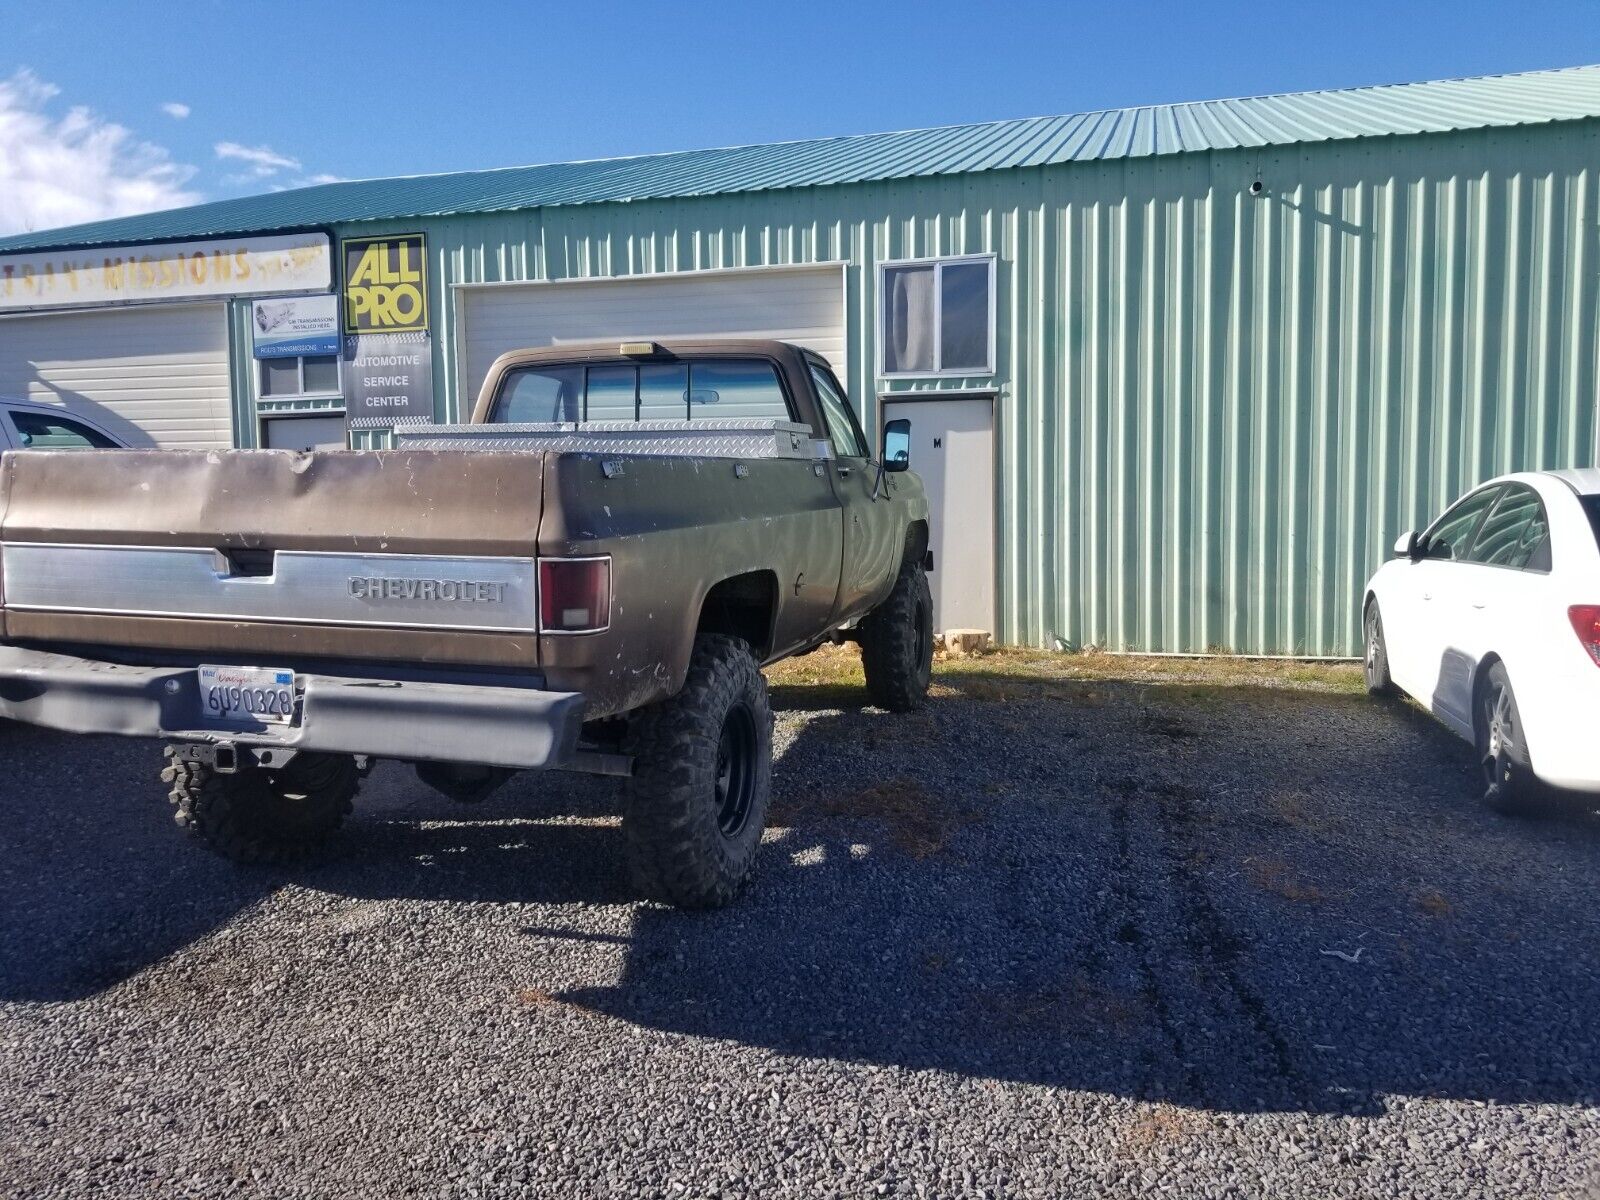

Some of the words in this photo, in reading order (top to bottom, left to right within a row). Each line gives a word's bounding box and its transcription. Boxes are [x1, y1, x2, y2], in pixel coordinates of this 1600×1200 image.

[348, 241, 420, 286] ALL
[348, 283, 423, 327] PRO
[277, 344, 317, 353] TRANSMISSIONS
[352, 355, 420, 368] AUTOMOTIVE
[363, 375, 409, 388] SERVICE
[365, 395, 409, 407] CENTER
[933, 437, 942, 449] M
[347, 575, 508, 604] CHEVROLET
[208, 685, 291, 716] 6U90328
